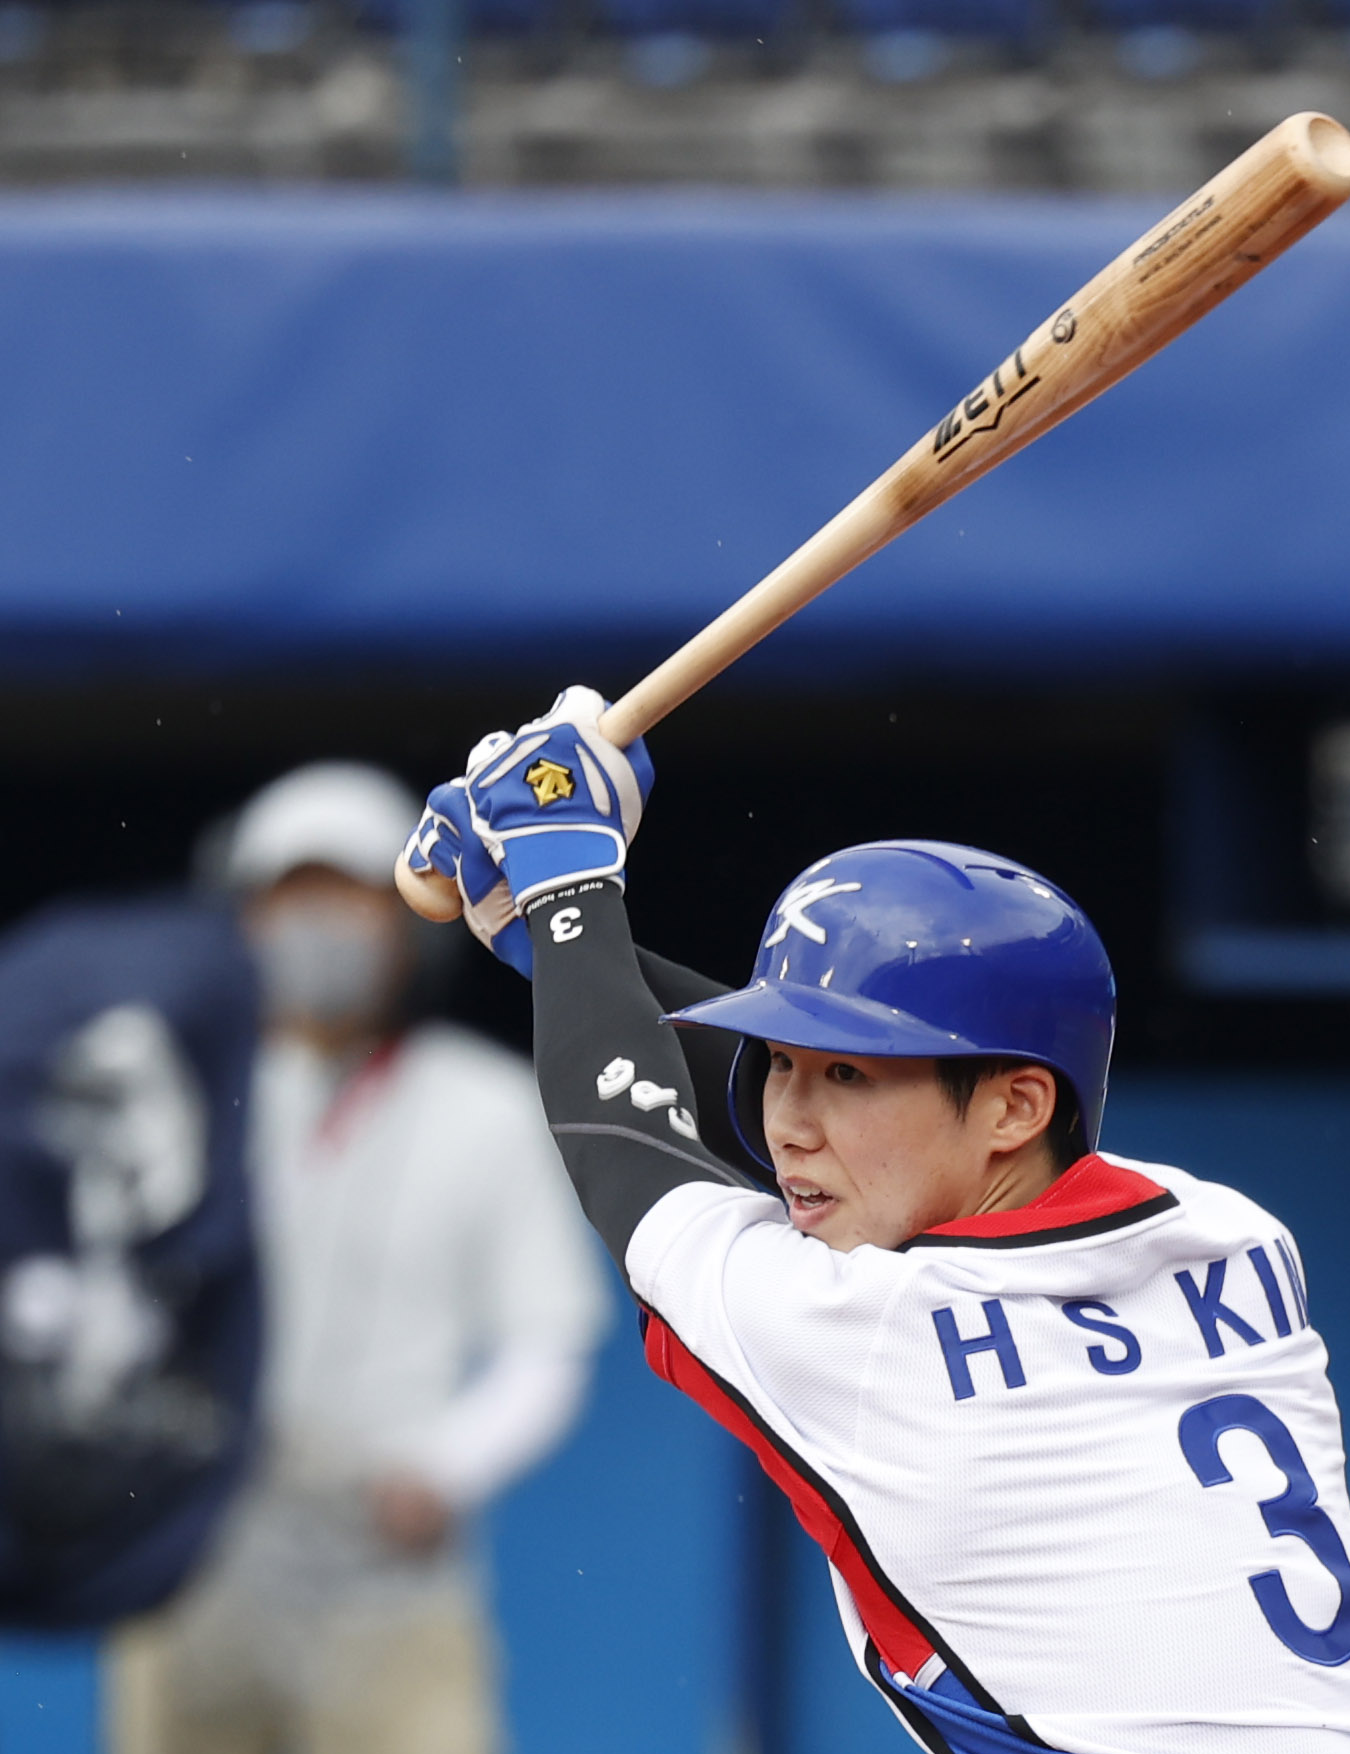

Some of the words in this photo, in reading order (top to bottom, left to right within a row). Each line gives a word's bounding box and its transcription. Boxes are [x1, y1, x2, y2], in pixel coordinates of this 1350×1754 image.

[549, 906, 583, 943] 3
[932, 1299, 1027, 1401] H
[1062, 1300, 1142, 1376] S
